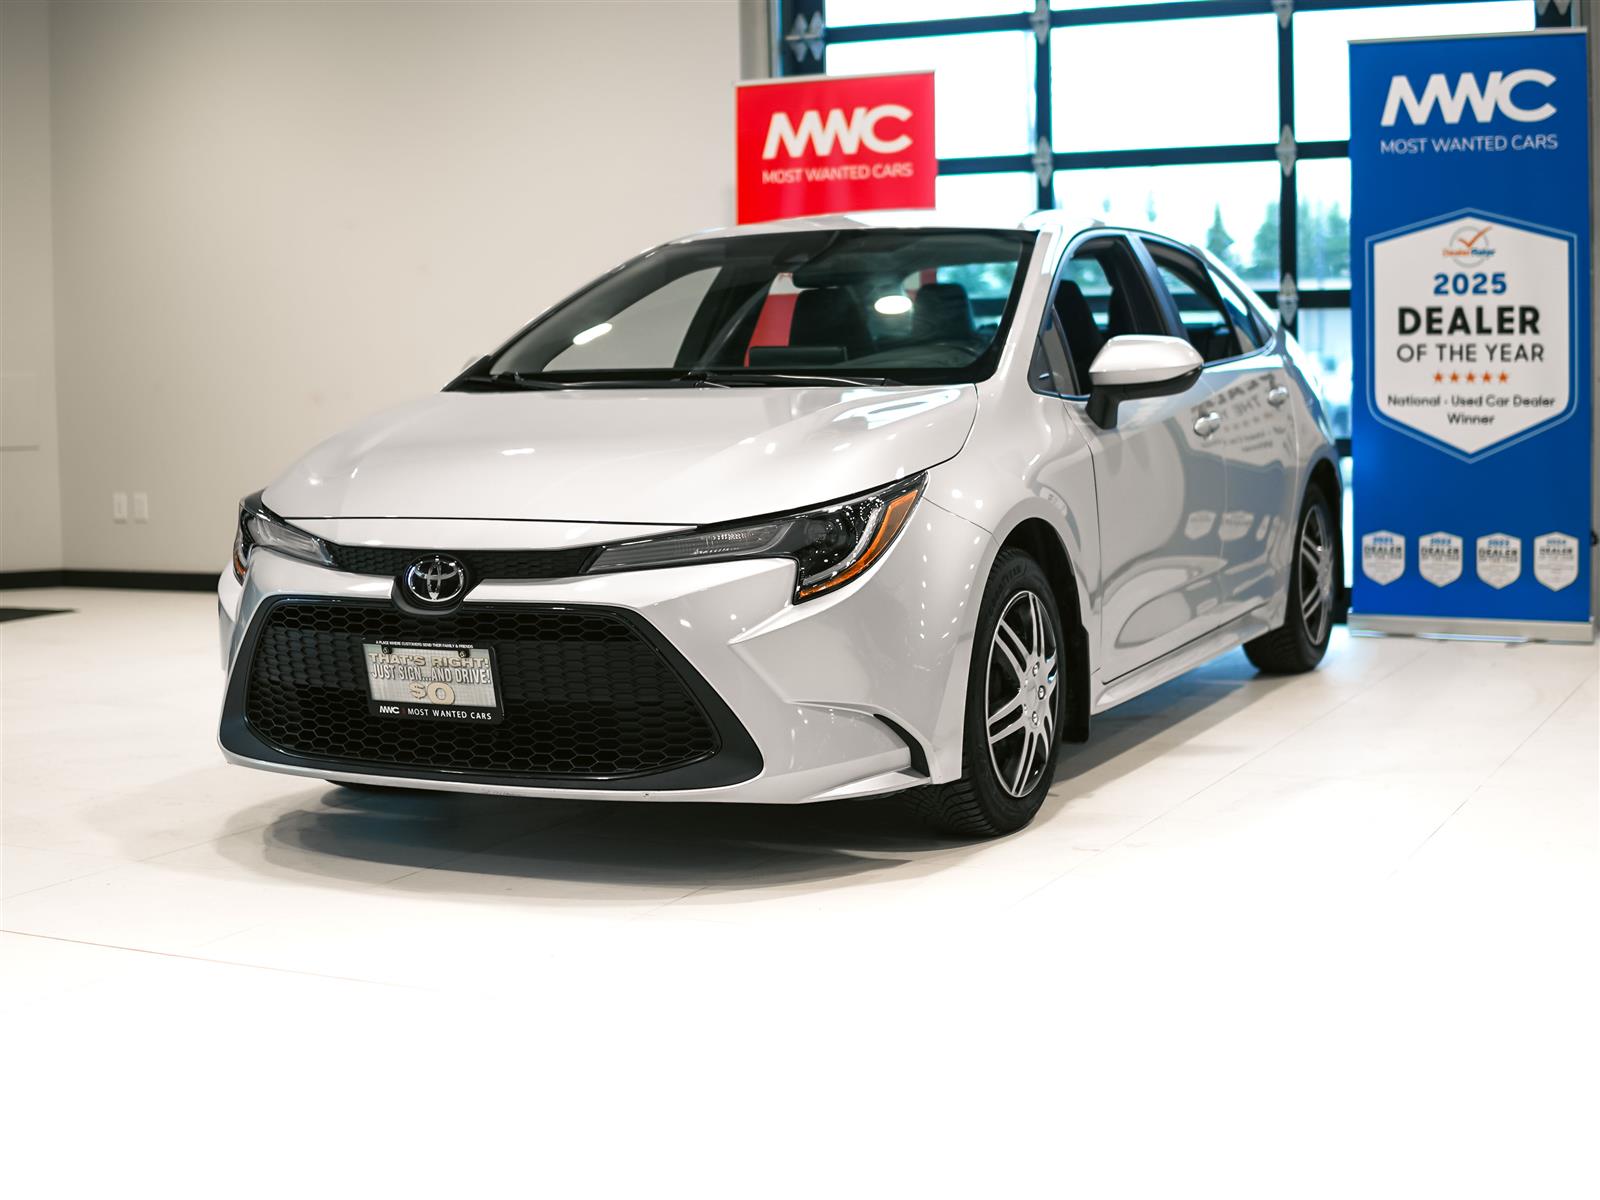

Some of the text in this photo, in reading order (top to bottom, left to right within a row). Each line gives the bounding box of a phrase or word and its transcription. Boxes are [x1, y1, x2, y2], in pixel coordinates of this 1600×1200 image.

[1380, 68, 1557, 127] MWC
[762, 104, 913, 160] MWC
[1380, 133, 1558, 155] MOST WANTED CARS
[762, 162, 913, 185] MOST WANTED CARS
[1433, 272, 1507, 295] 2025
[1398, 306, 1541, 335] DEALER
[1397, 343, 1544, 363] OF THE YEAR
[1387, 395, 1440, 407] National
[1451, 395, 1483, 407] Used
[1485, 395, 1509, 407] Car
[1513, 395, 1556, 407] Dealer
[1447, 412, 1495, 425] Winner
[368, 653, 490, 669] THAT'S RIGHT!
[371, 664, 396, 680] JUST
[454, 668, 492, 685] DRIVE!
[380, 705, 492, 720] MWC MOST WANTED CARS
